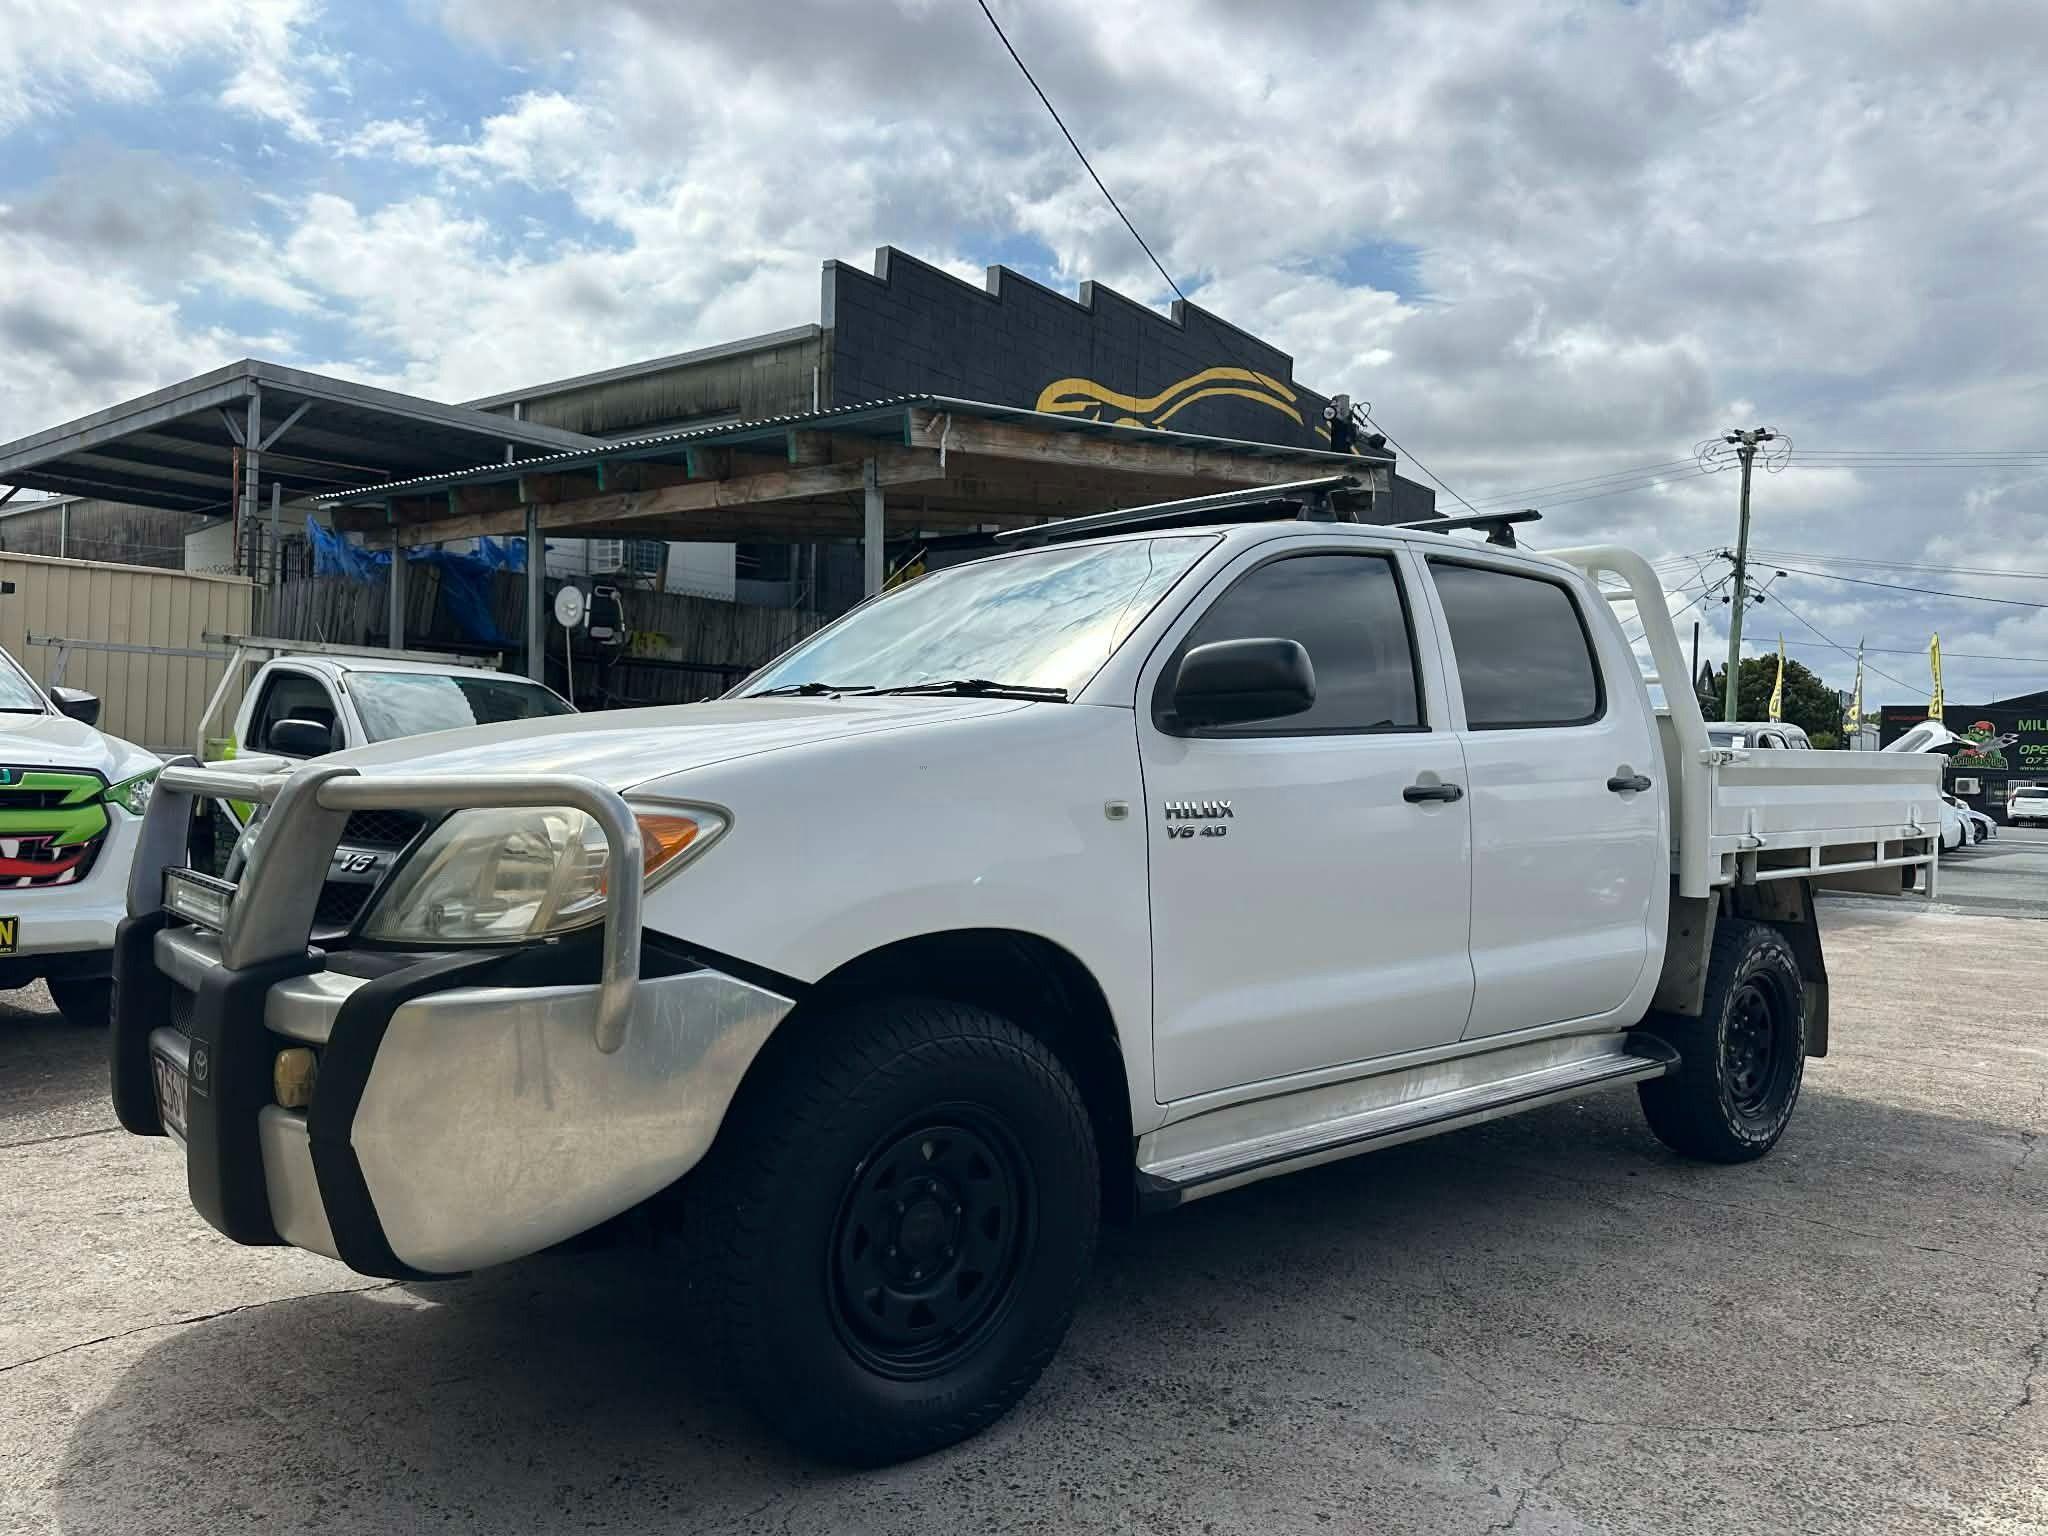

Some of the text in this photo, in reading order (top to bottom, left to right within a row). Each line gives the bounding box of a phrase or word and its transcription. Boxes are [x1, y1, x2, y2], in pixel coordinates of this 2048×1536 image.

[2018, 720, 2048, 731] MIL
[1165, 800, 1234, 820] HILUX
[1167, 824, 1195, 839] V6
[341, 854, 377, 872] V6
